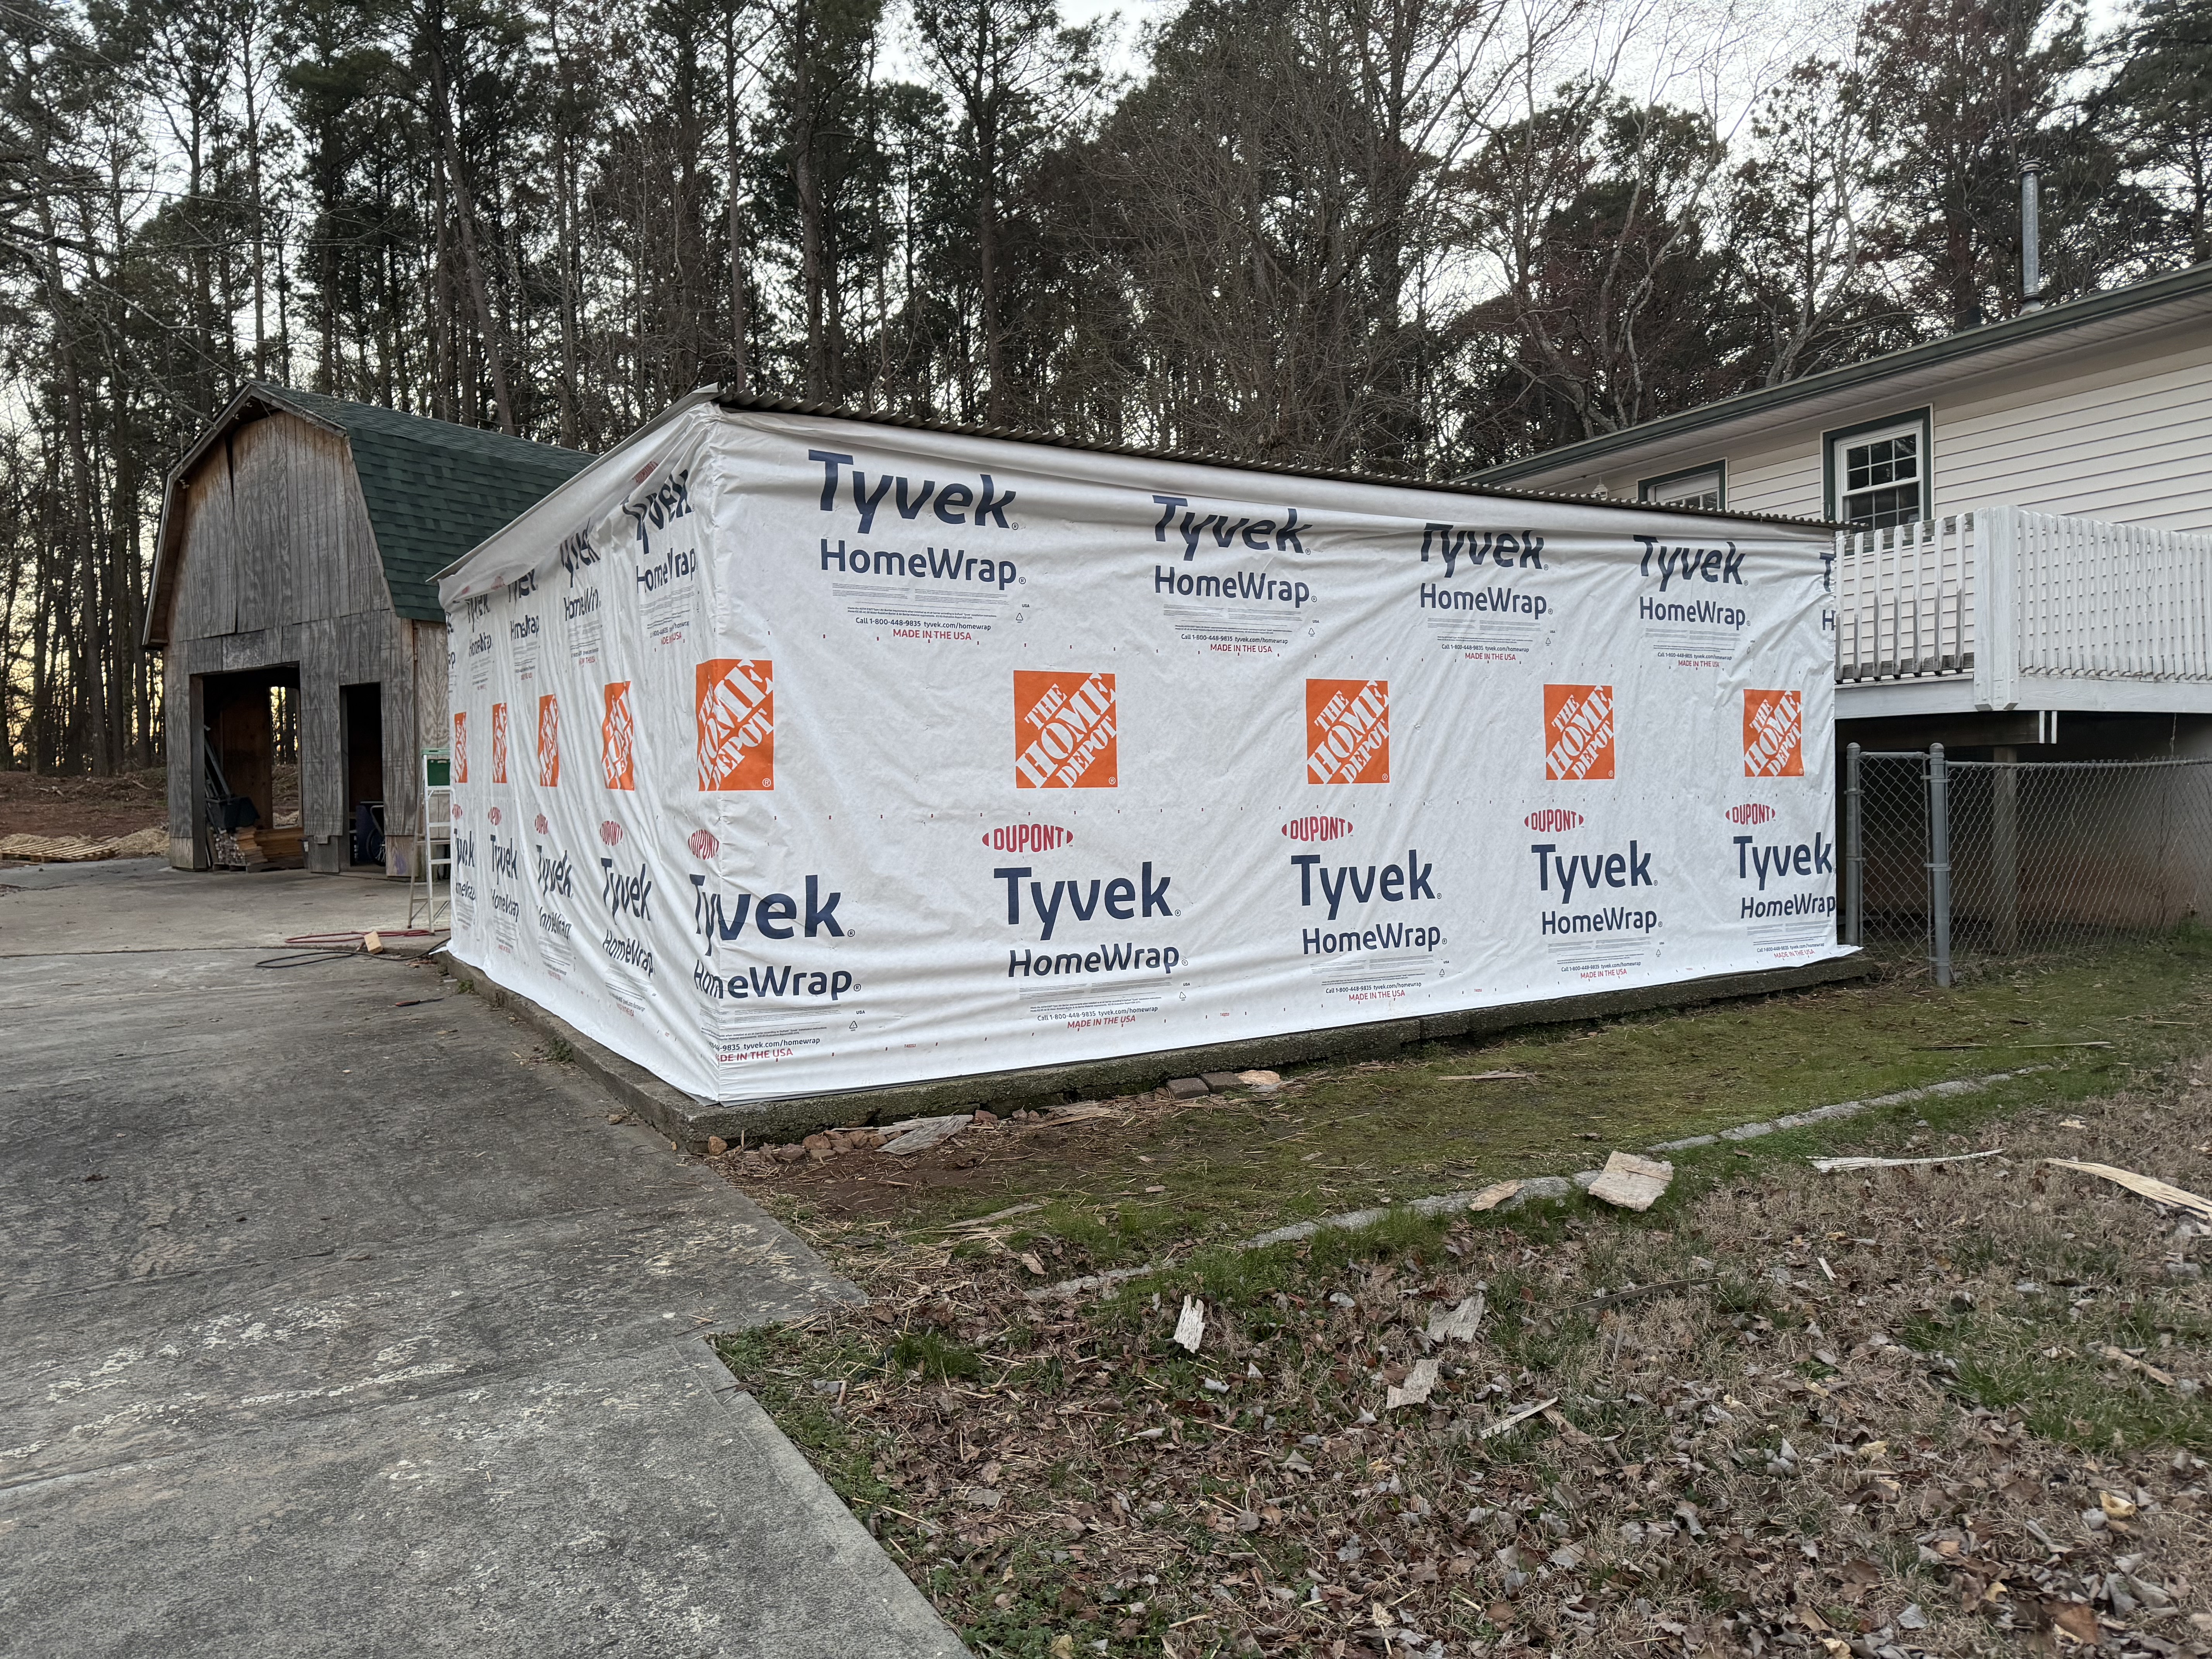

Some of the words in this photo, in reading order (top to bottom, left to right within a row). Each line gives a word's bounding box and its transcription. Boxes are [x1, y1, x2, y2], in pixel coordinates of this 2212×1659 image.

[808, 449, 1016, 534] Tyvek
[1152, 495, 1313, 561] Tyvek
[1421, 523, 1544, 578] Tyvek
[821, 539, 1016, 590] HomeWrap
[1155, 565, 1310, 608] HomeWrap
[1633, 535, 1746, 592] Tyvek
[870, 618, 921, 627] 1-800-448-9835
[924, 622, 991, 631] tyvek.com/homewrap
[1420, 583, 1547, 620] HomeWrap
[1640, 596, 1745, 630] HomeWrap
[893, 629, 920, 638] MADE
[934, 631, 951, 639] THE
[954, 632, 972, 640] USA
[697, 658, 774, 791] HOME
[1024, 683, 1067, 730] THE
[1314, 690, 1349, 732] THE
[1551, 695, 1580, 732] THE
[1749, 699, 1773, 733] THE
[713, 708, 774, 791] DEPOT
[1015, 673, 1116, 788] HOME
[1056, 716, 1116, 788] DEPOT
[1307, 680, 1389, 784] HOME
[1340, 718, 1389, 783] DEPOT
[1546, 685, 1613, 780] HOME
[1571, 720, 1614, 779] DEPOT
[1744, 690, 1802, 777] HOME
[1766, 722, 1801, 777] DEPOT
[994, 824, 1064, 852] DUPONT
[1290, 816, 1345, 842] DUPONT
[1531, 809, 1577, 832] DUPONT
[1732, 804, 1770, 825] DUPONT
[490, 834, 518, 885] Tyvek
[1531, 840, 1652, 904] Tyvek
[1733, 832, 1832, 891] Tyvek
[601, 857, 652, 926] Tyvek
[994, 861, 1173, 941] Tyvek
[1291, 849, 1435, 920] Tyvek
[1741, 893, 1836, 919] HomeWrap
[689, 874, 845, 957] Tyvek
[1302, 923, 1440, 954] HomeWrap
[1542, 907, 1657, 935] HomeWrap
[694, 959, 852, 1000] HomeWrap
[1008, 943, 1179, 977] HomeWrap
[1050, 1011, 1096, 1020] 1-800-448-9835
[1098, 1007, 1158, 1017] tyvek.com/homewrap
[1349, 993, 1368, 1001] MADE
[744, 1038, 820, 1049] tyvek.com/homewrap
[1067, 1019, 1091, 1029] MADE
[737, 1053, 747, 1061] IN
[750, 1050, 770, 1059] THE
[773, 1048, 793, 1057] USA
